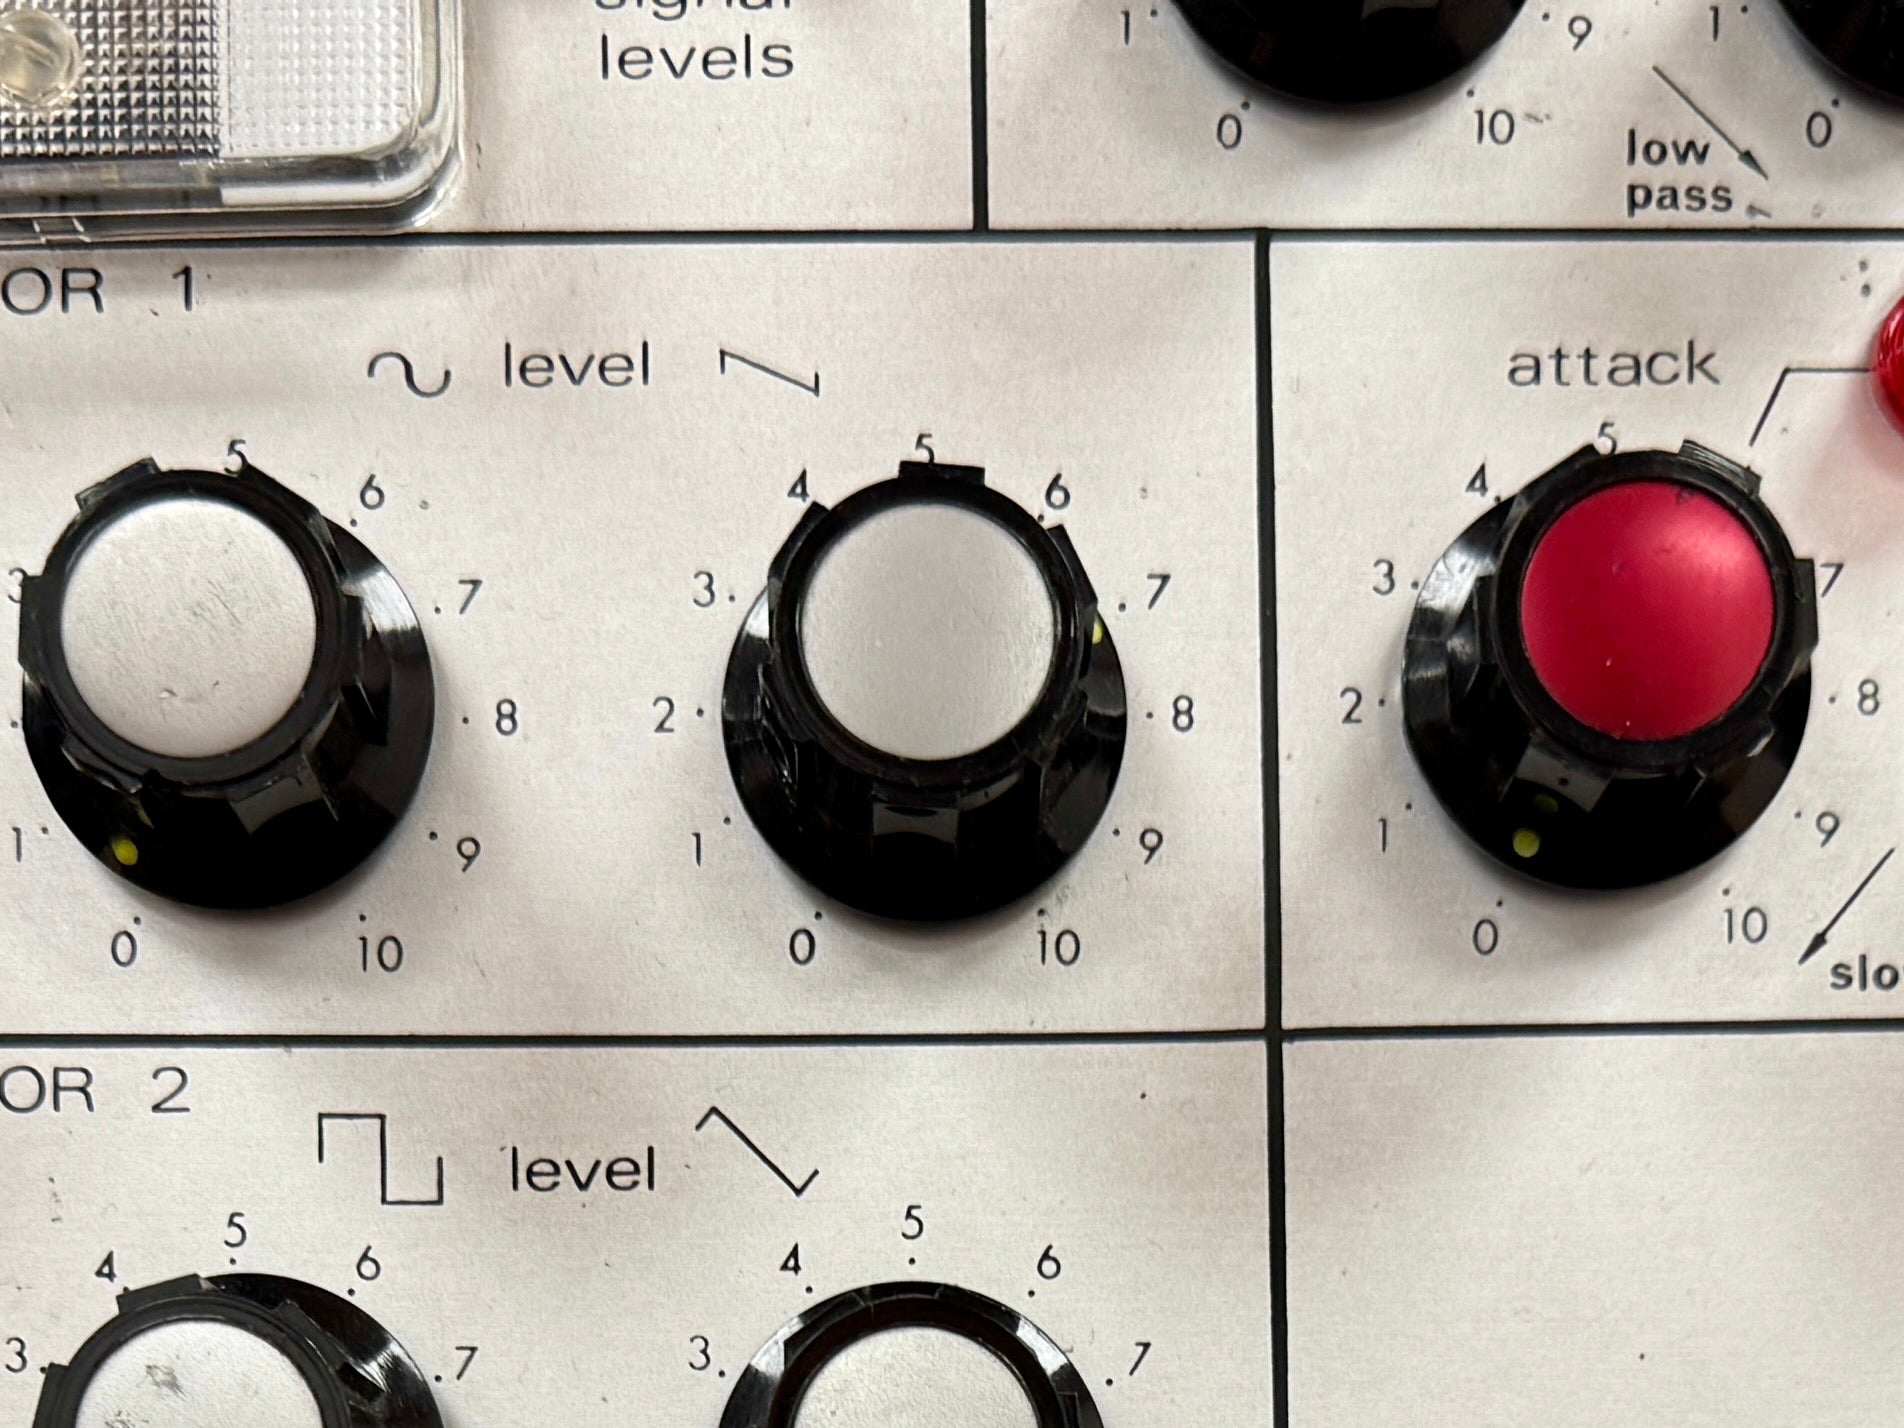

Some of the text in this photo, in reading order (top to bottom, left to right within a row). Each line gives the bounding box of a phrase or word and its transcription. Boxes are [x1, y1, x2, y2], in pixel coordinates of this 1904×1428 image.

[601, 32, 793, 80] levels
[1627, 128, 1710, 166] low
[1627, 183, 1732, 218] pass
[172, 265, 192, 311] 1
[505, 339, 649, 388] level
[1508, 338, 1720, 387] attack
[151, 1066, 190, 1113] 2
[512, 1145, 654, 1192] level
[901, 1204, 923, 1240] 5
